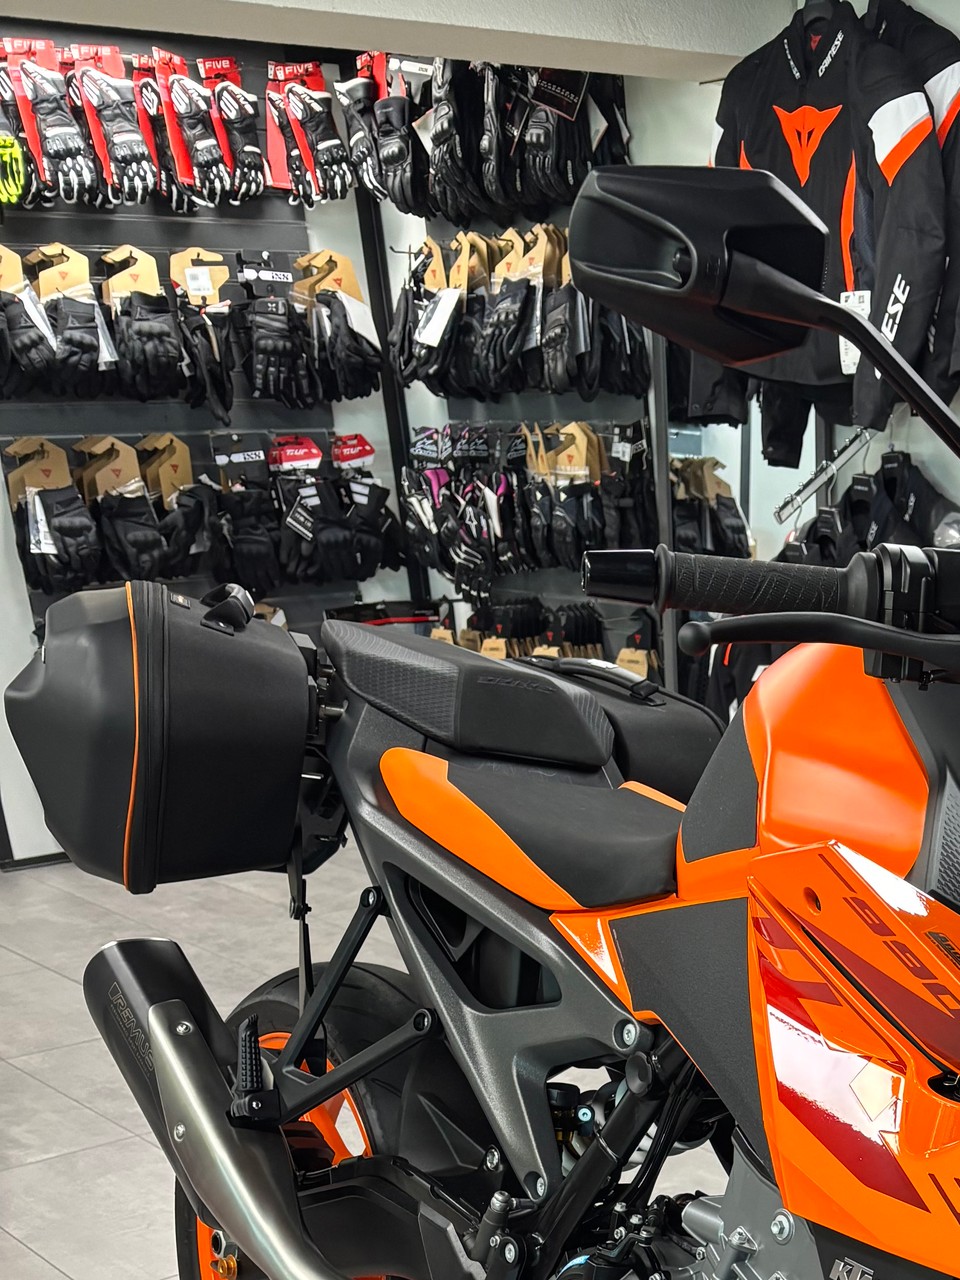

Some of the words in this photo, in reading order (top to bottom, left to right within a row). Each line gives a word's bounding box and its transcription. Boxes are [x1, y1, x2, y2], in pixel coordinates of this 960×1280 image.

[204, 59, 230, 69] FIVE
[818, 29, 845, 77] DAINESE
[285, 63, 313, 75] FIVE
[113, 996, 154, 1071] REMUS
